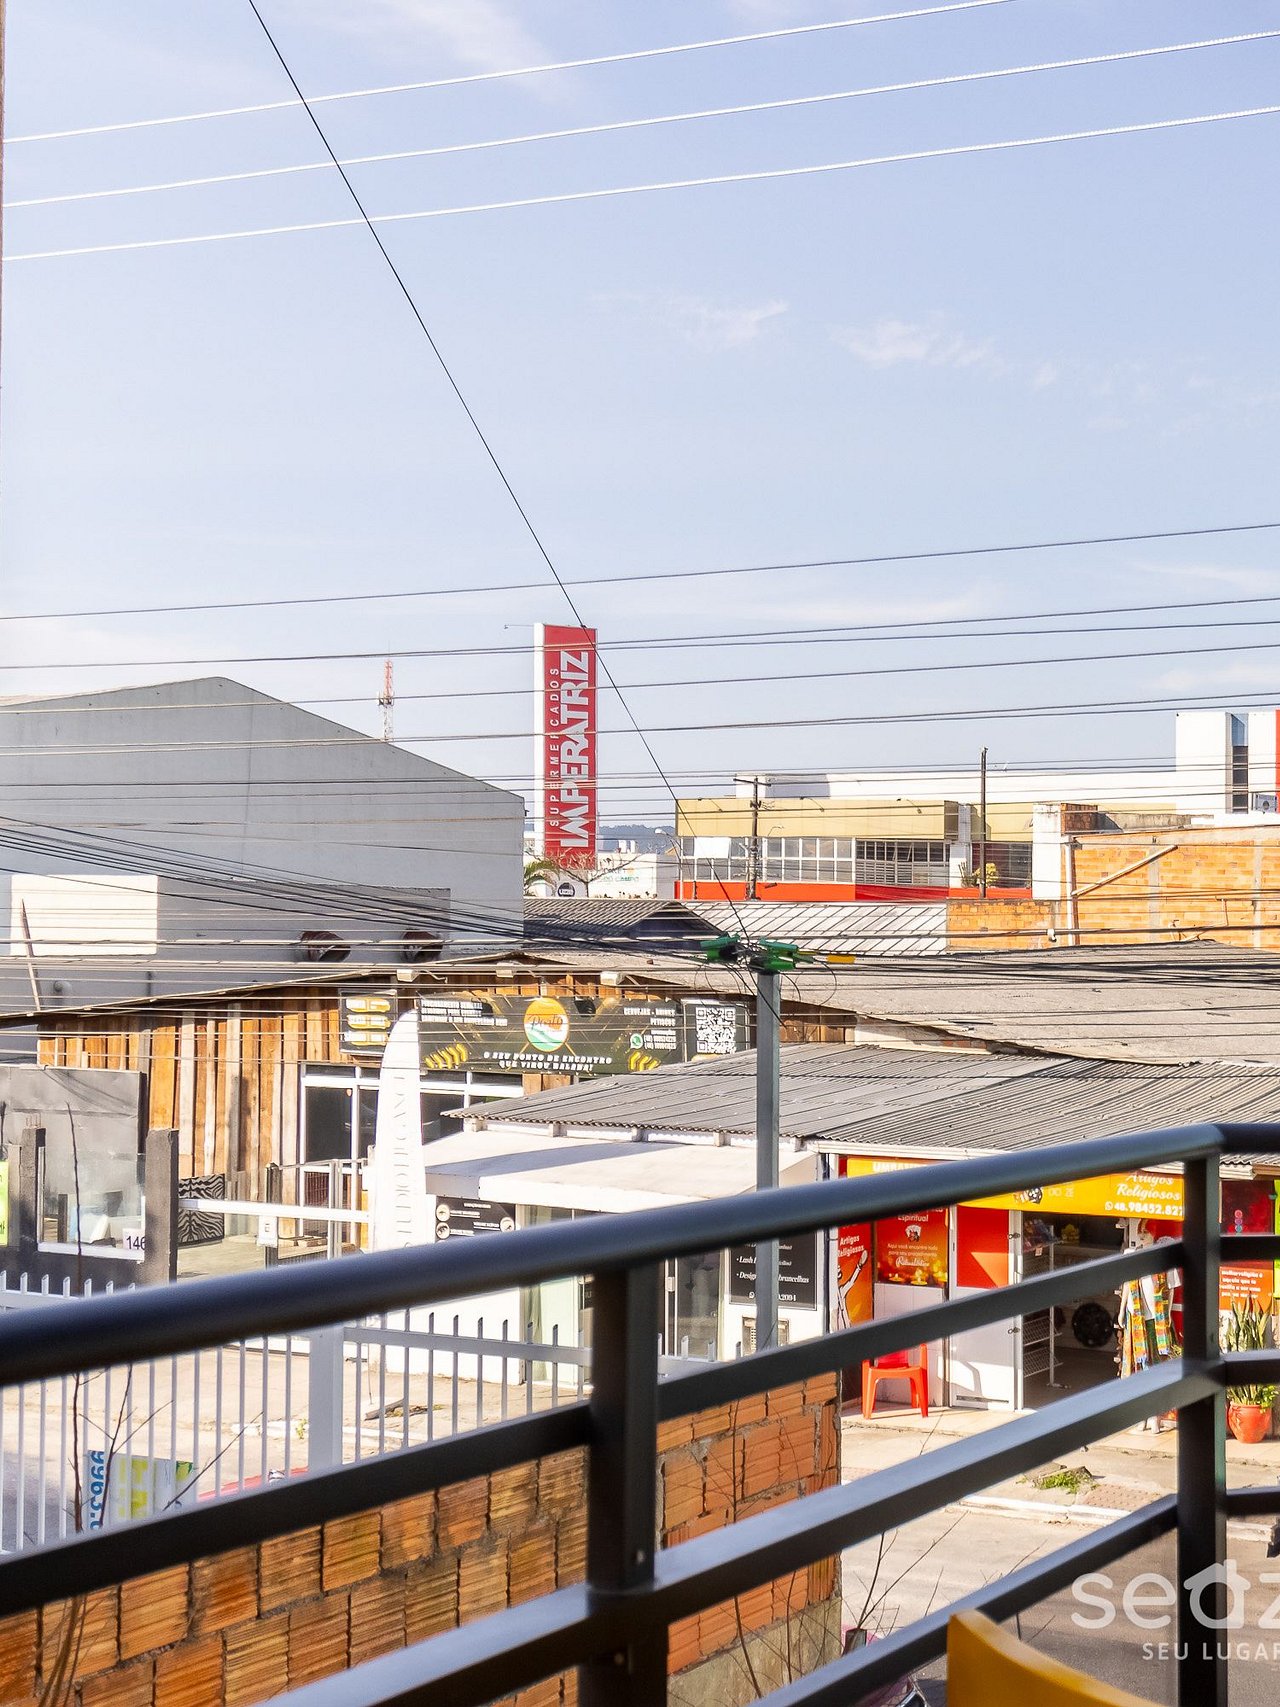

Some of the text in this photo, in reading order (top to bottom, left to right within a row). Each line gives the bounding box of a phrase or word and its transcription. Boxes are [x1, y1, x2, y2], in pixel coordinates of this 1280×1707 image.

[560, 651, 589, 848] IMPERATRIZ
[1125, 1171, 1174, 1186] Artigos
[1116, 1183, 1181, 1200] Religiosos
[1114, 1202, 1184, 1217] 48.98452.827
